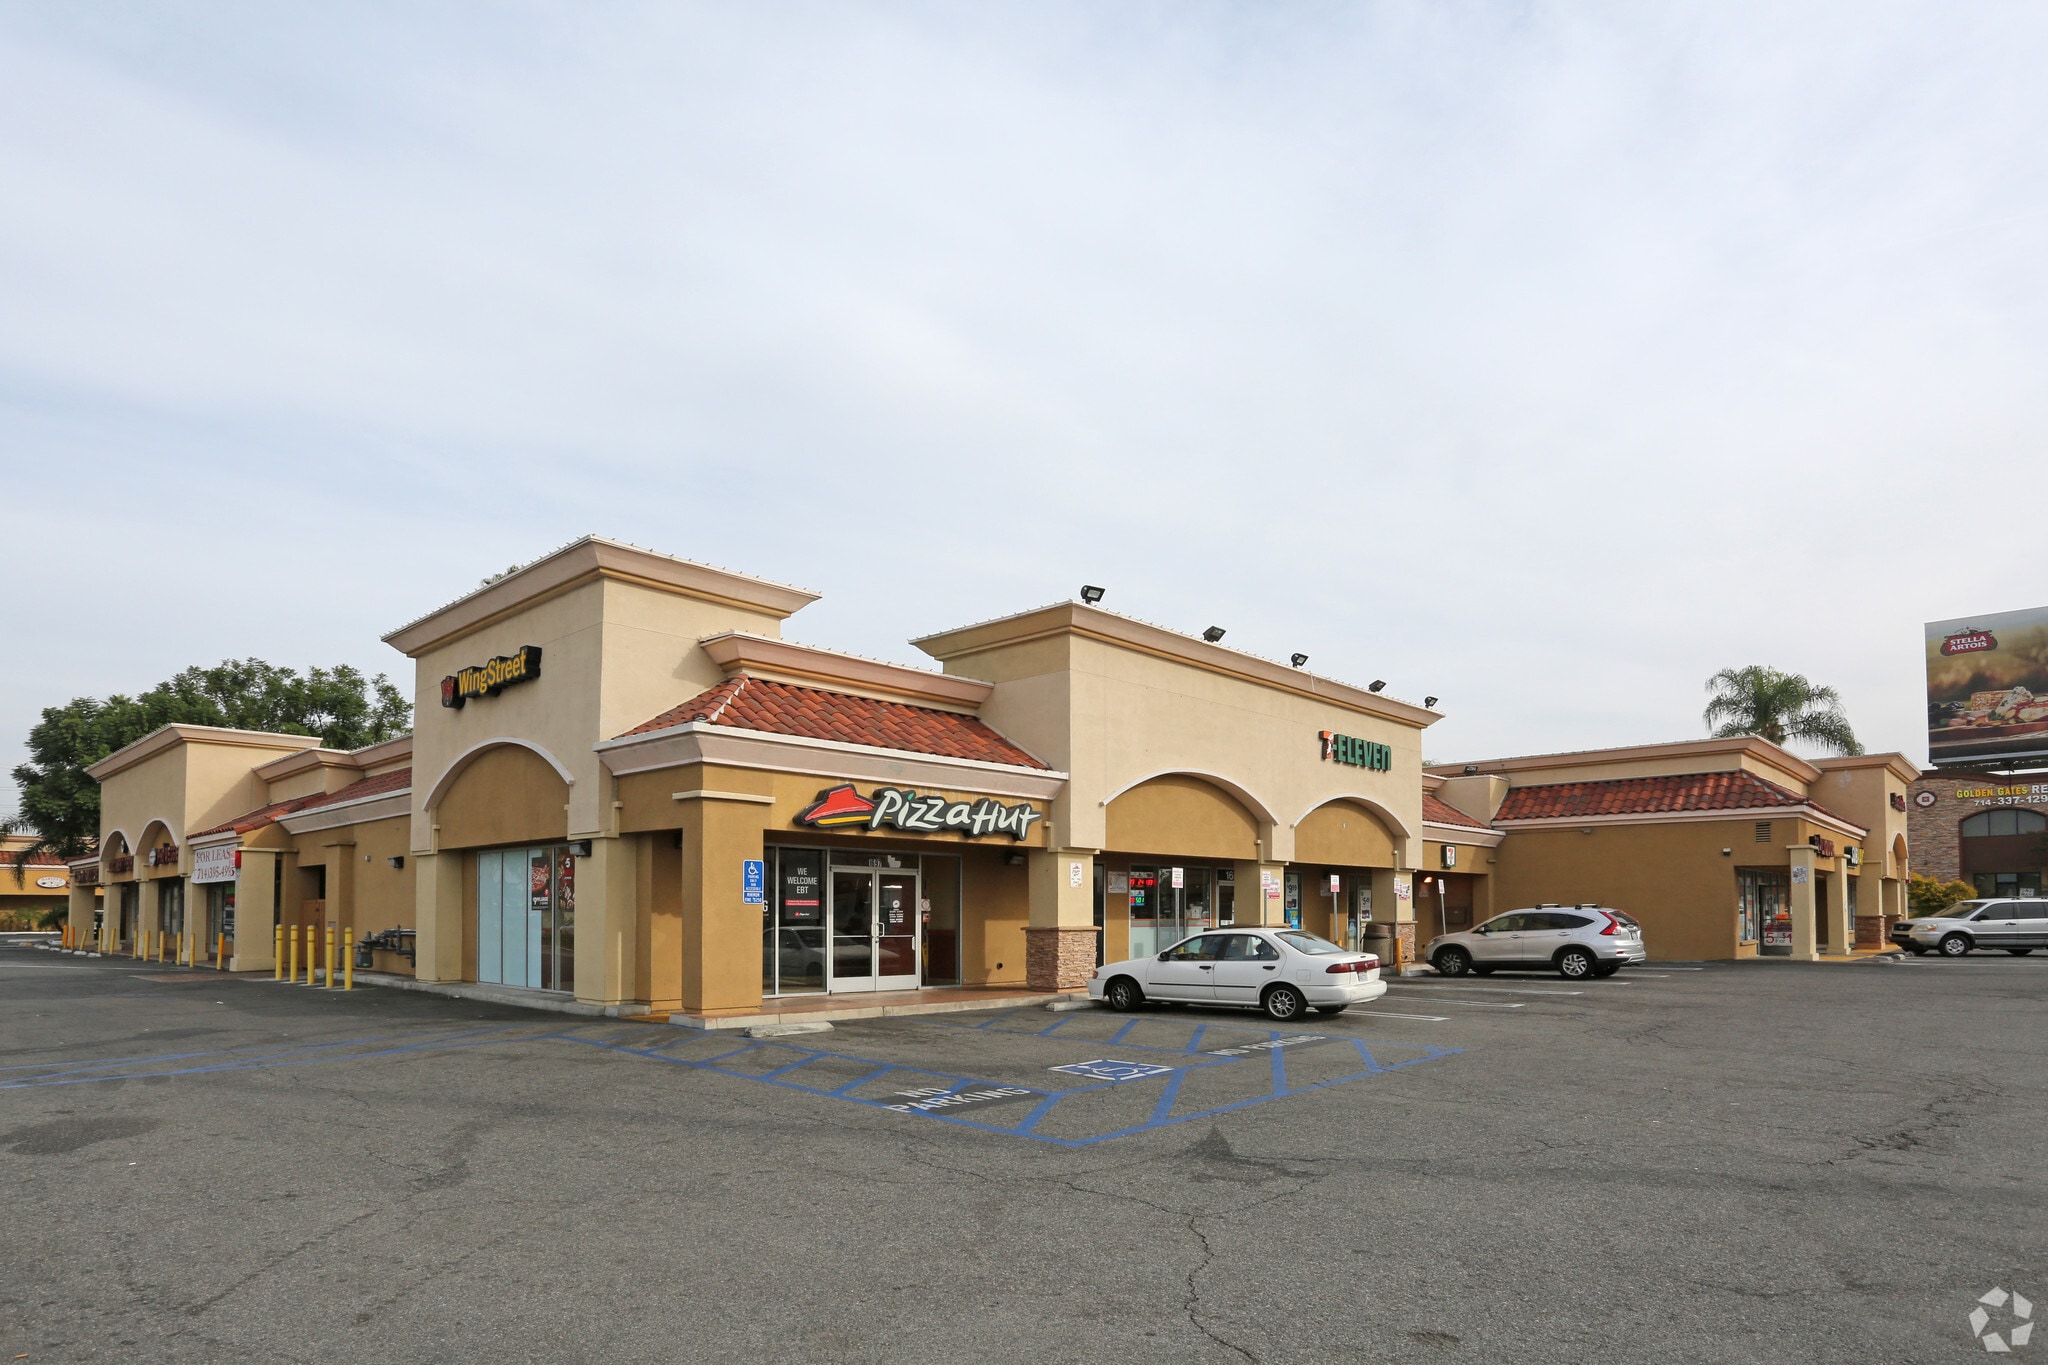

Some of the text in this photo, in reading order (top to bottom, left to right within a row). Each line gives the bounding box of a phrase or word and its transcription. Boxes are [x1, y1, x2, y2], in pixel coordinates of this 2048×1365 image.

[1950, 636, 1987, 645] STELLA
[1951, 642, 1988, 651] ARTOIS
[459, 650, 526, 695] WingStreet
[1956, 785, 2048, 798] GOLDEN GATES RE
[871, 790, 1041, 838] Pizza Hut
[196, 850, 211, 863] FOR
[212, 847, 236, 861] LEAS
[797, 867, 808, 876] WE
[786, 876, 818, 885] WELCOME
[796, 885, 809, 894] EBT
[1765, 932, 1775, 944] 5
[894, 1087, 952, 1098] NO
[882, 1087, 1031, 1113] PARKING
